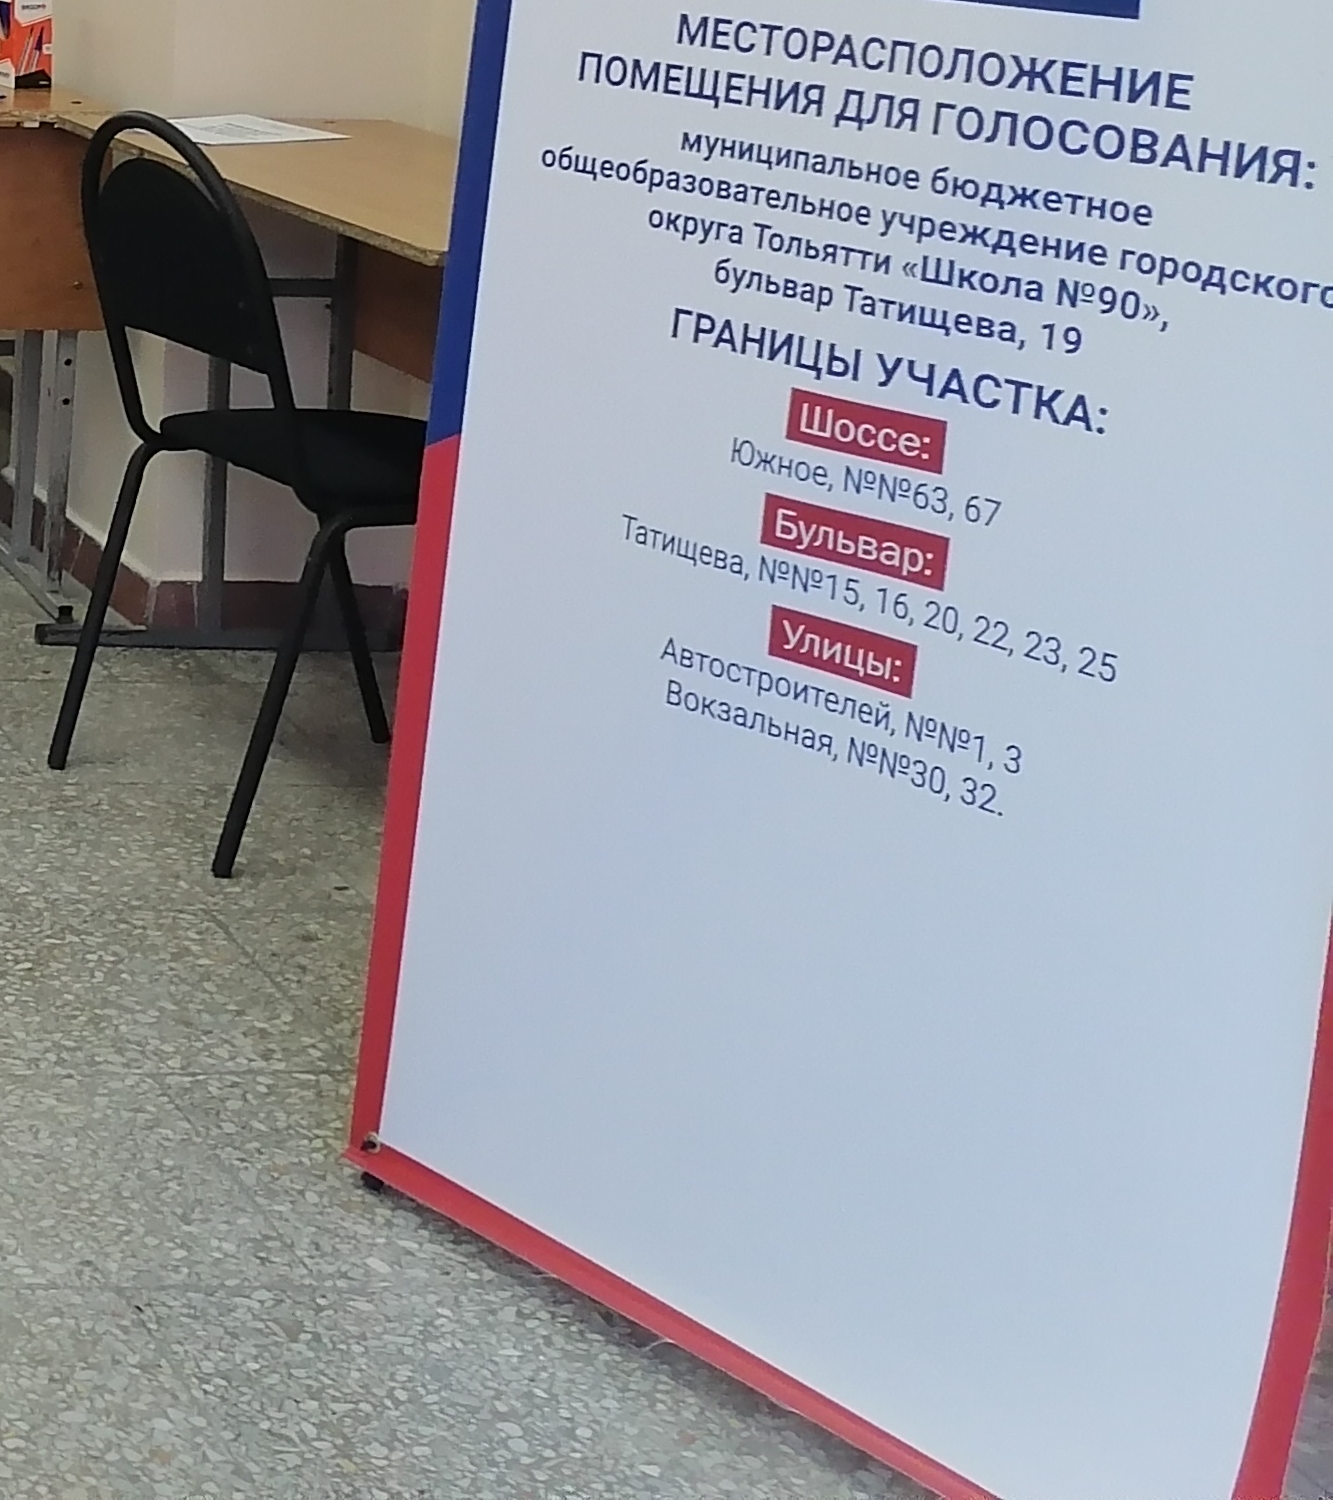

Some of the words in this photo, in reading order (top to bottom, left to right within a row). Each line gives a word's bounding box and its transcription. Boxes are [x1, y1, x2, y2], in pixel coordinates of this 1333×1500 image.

[677, 13, 1194, 110] МЕСТОРАСПОЛОЖЕНИЕ
[578, 51, 825, 117] ПОМЕЩЕНИЯ
[834, 89, 920, 132] ДЛЯ
[932, 102, 1318, 190] ГОЛОСОВАНИЯ:
[542, 146, 871, 225] общеобразовательное
[879, 209, 1108, 266] учреждение
[681, 132, 920, 190] муниципальное
[931, 167, 1153, 226] бюджетное
[649, 210, 743, 245] округа
[753, 222, 891, 275] Тольятти
[903, 255, 1043, 302] «Школа
[1056, 278, 1168, 332] №90»,
[715, 258, 833, 312] бульвар
[844, 284, 1025, 350] Татищева,
[1042, 323, 1082, 354] 19
[671, 308, 862, 381] ГРАНИЦЫ
[876, 353, 1108, 434] УЧАСТКА:
[731, 437, 832, 491] Южное,
[844, 466, 954, 521] №№63,
[965, 496, 1002, 526] 67
[800, 403, 930, 459] Шоссе:
[776, 509, 933, 575] Бульвар:
[622, 514, 749, 581] Татищева,
[759, 556, 864, 611] №№15,
[878, 589, 913, 626] 16,
[924, 601, 964, 641] 20,
[973, 616, 1013, 657] 22,
[1023, 631, 1067, 673] 23,
[1078, 647, 1118, 682] 25
[783, 620, 901, 682] Улицы:
[660, 637, 895, 736] Автостроителей,
[905, 712, 993, 770] №№1,
[1003, 745, 1022, 774] 3
[666, 679, 838, 762] Вокзальная,
[847, 737, 950, 802] №№30,
[960, 777, 1003, 816] 32.
